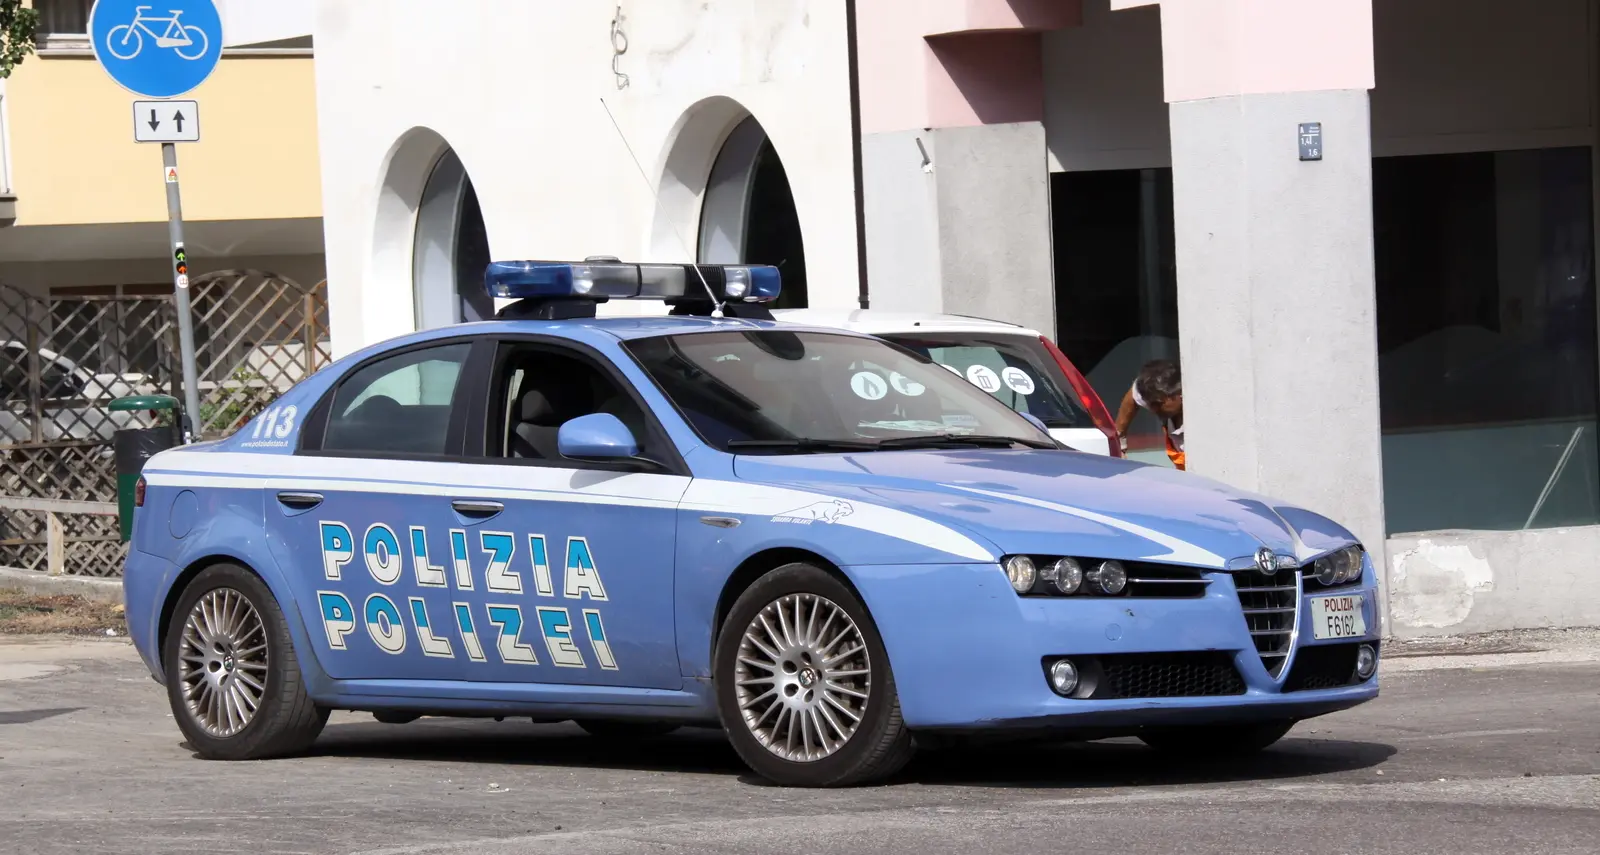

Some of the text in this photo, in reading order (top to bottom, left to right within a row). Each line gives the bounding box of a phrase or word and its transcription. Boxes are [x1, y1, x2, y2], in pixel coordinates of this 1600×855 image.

[251, 404, 298, 439] 113
[318, 520, 609, 601] POLIZIA
[1324, 597, 1354, 612] POLIZIA
[316, 589, 619, 671] POLIZEI
[1327, 615, 1356, 637] F6162
